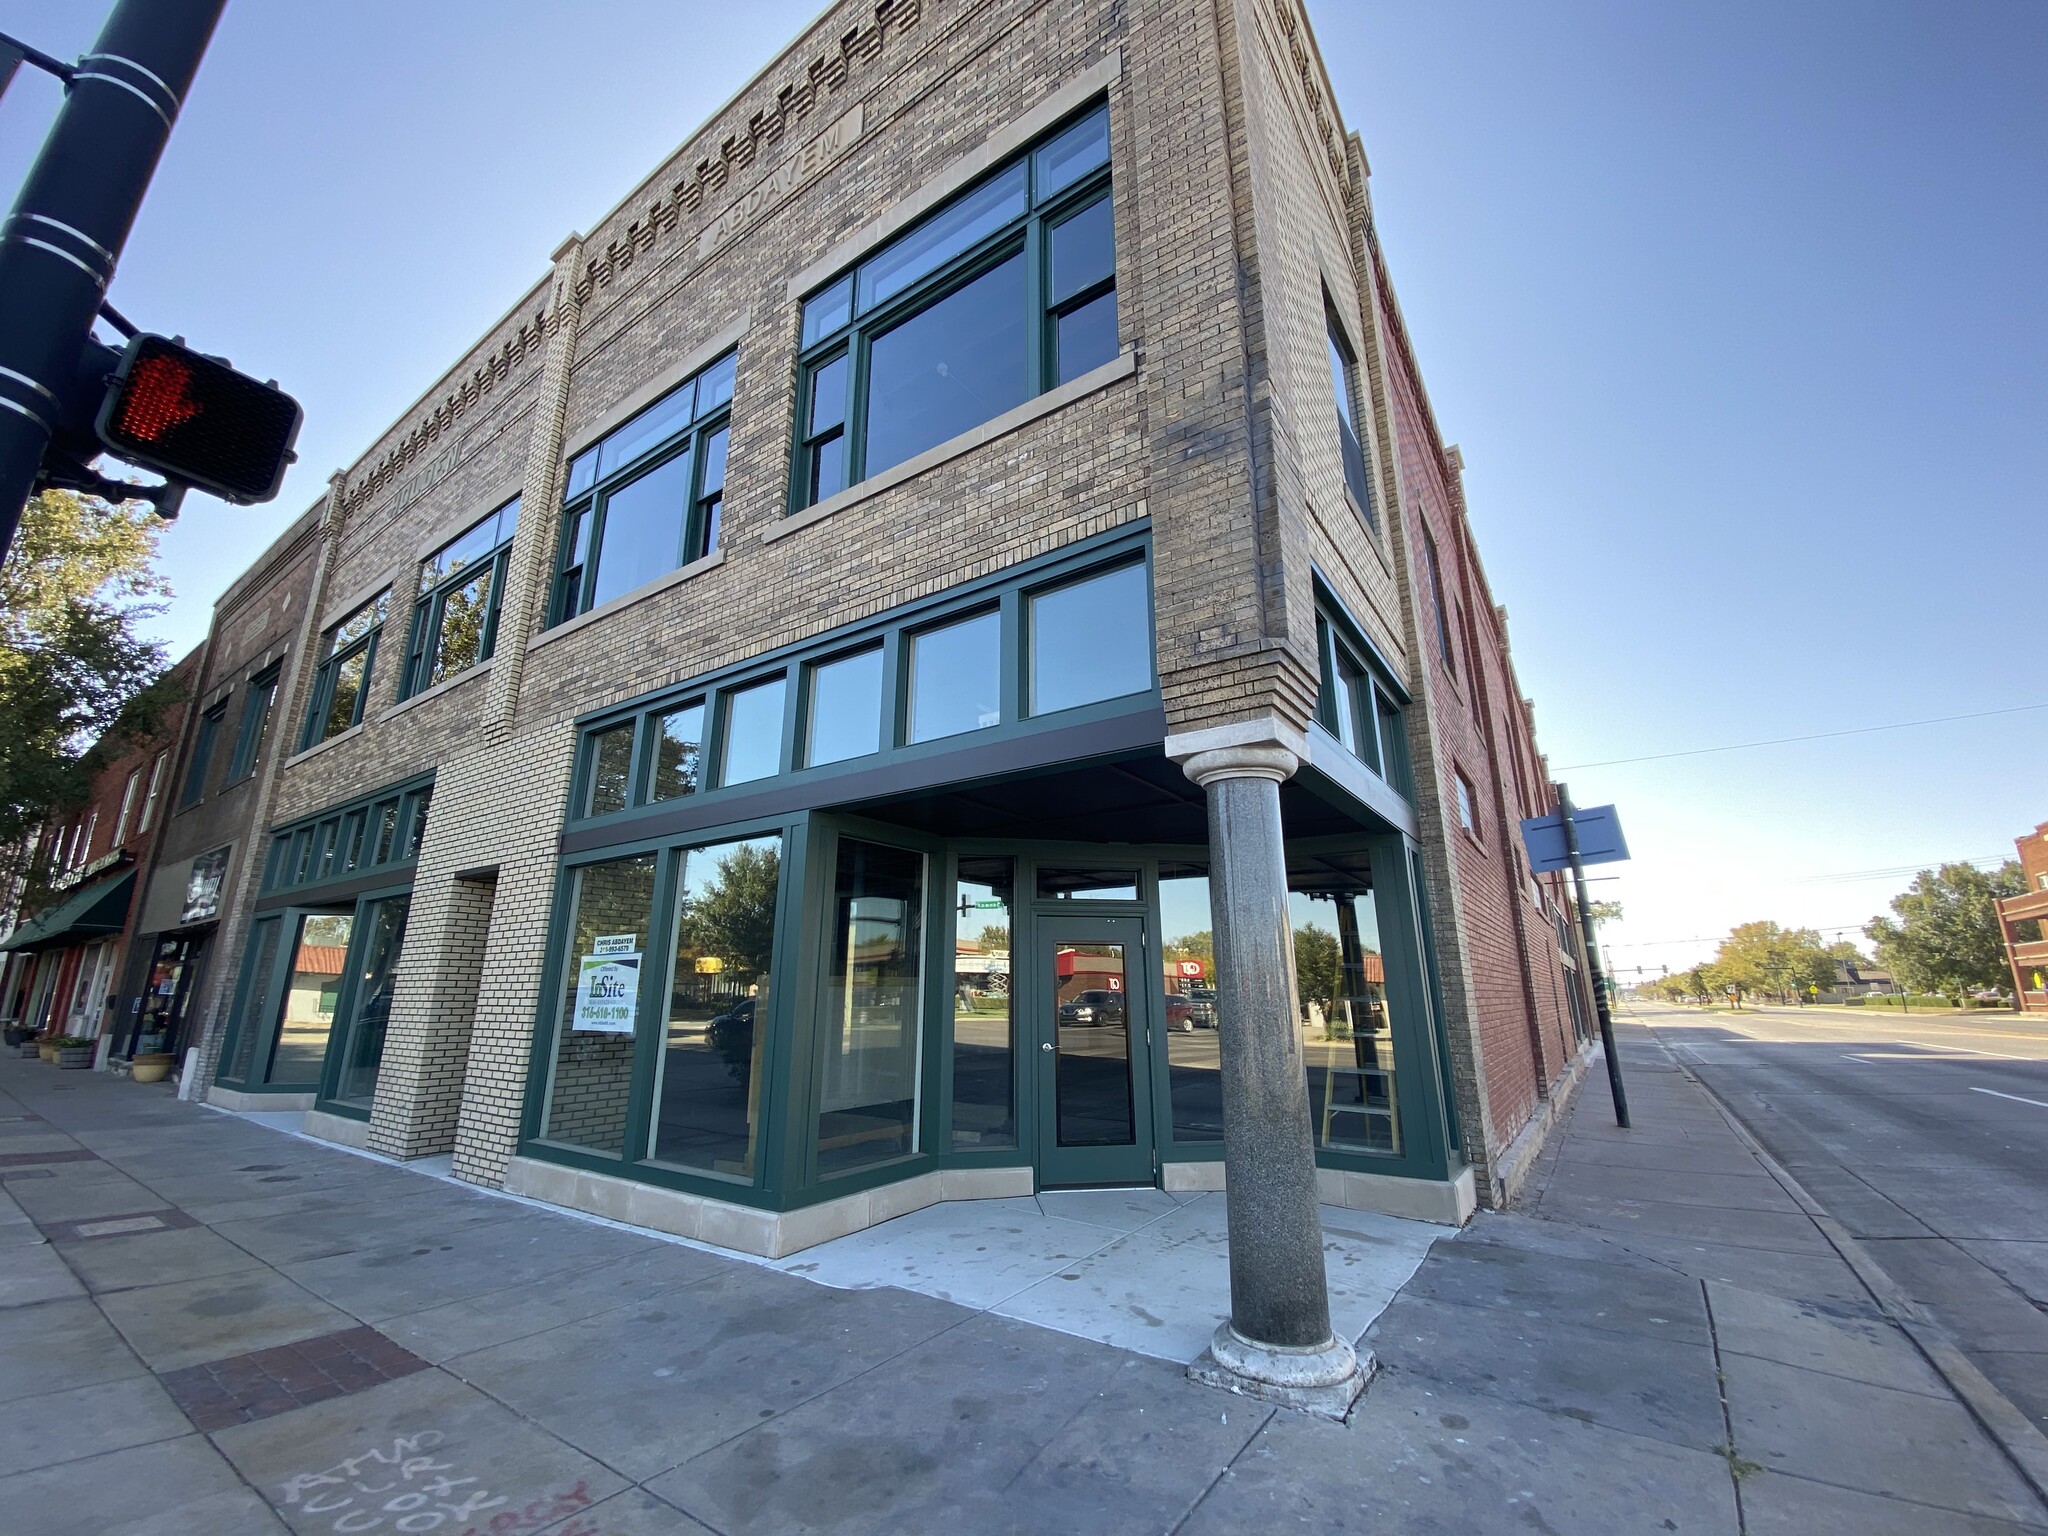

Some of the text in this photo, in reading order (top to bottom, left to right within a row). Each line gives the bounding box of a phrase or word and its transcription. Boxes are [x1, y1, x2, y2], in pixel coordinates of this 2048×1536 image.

[713, 123, 842, 245] ABDAYEM
[589, 975, 626, 998] InSite
[581, 1006, 629, 1020] 316-618-1100
